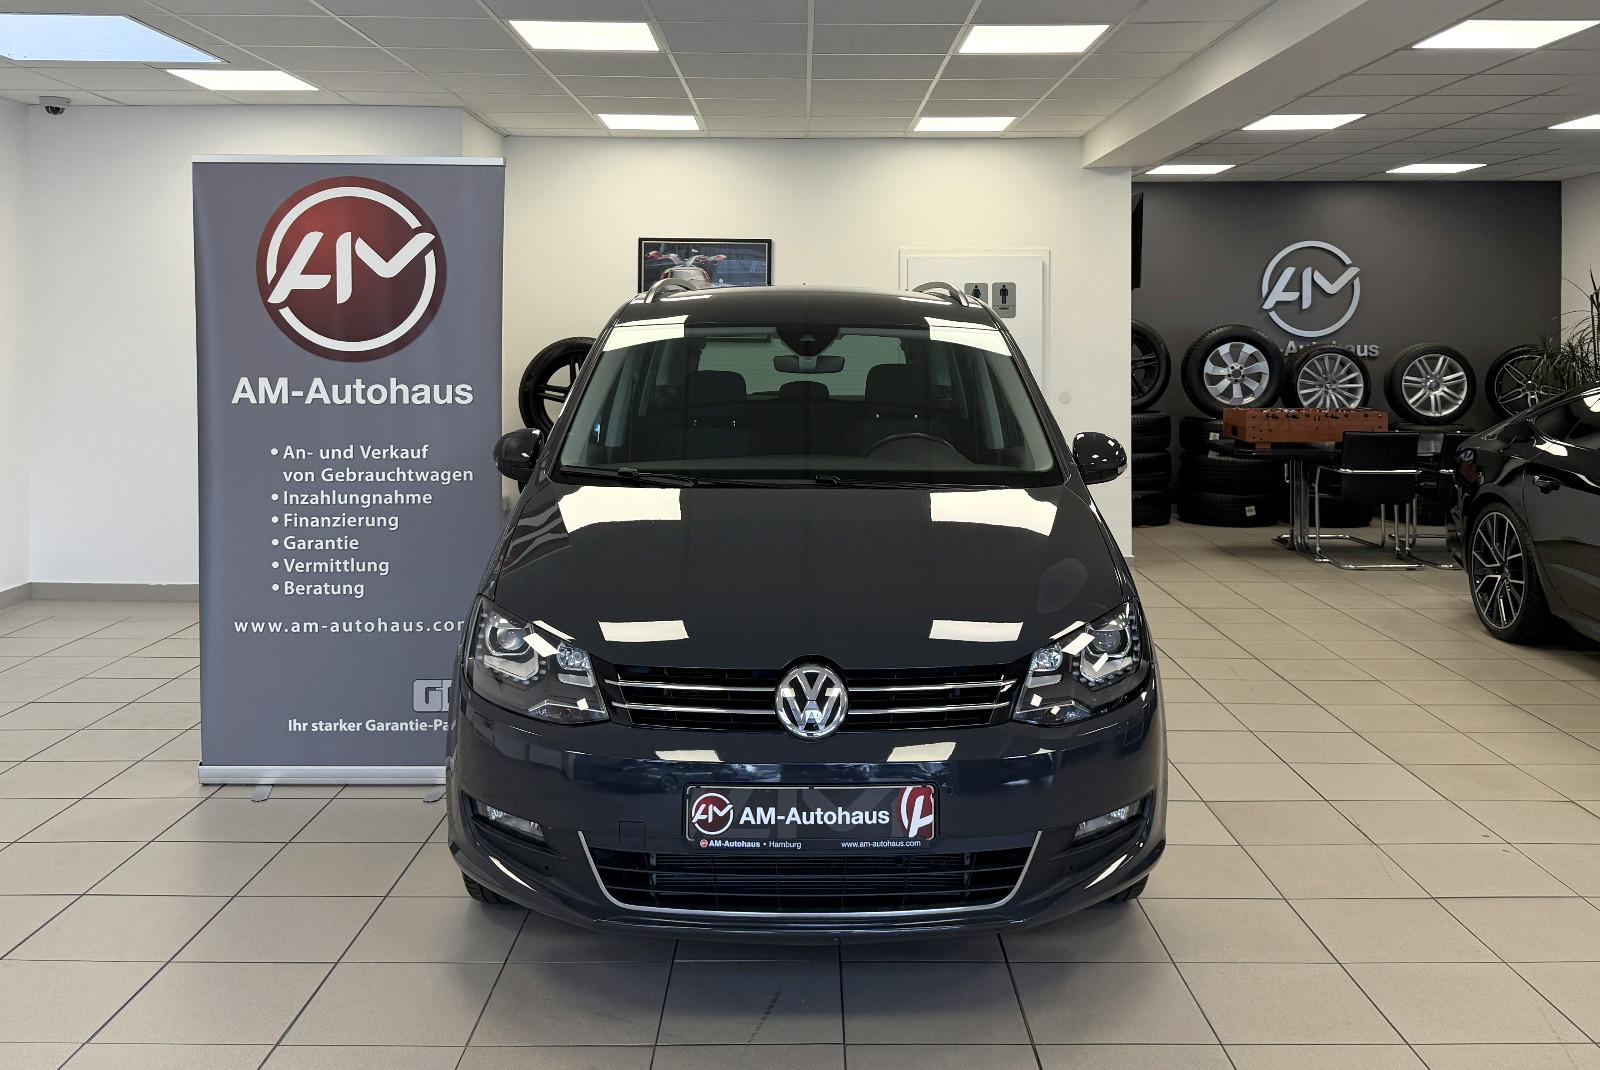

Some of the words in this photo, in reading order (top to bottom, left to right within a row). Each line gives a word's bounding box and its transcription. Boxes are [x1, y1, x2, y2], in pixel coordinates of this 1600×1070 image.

[231, 376, 474, 405] AM-Autohaus
[283, 445, 314, 460] An-
[319, 445, 354, 460] und
[360, 444, 429, 460] Verkauf
[283, 471, 315, 483] von
[321, 466, 474, 485] Gebrauchtwagen
[283, 489, 433, 509] Inzahlungnahme
[283, 512, 399, 531] Finanzierung
[283, 535, 359, 550] Garantie
[283, 557, 389, 576] Vermittlung
[284, 580, 365, 599] Beratung
[288, 718, 309, 732] Ihr
[311, 718, 363, 732] starker
[739, 806, 890, 826] AM-Autohaus
[708, 839, 761, 849] AM-Autohaus
[768, 840, 802, 850] Hamburg
[840, 839, 922, 849] www.am-autohaus.com
